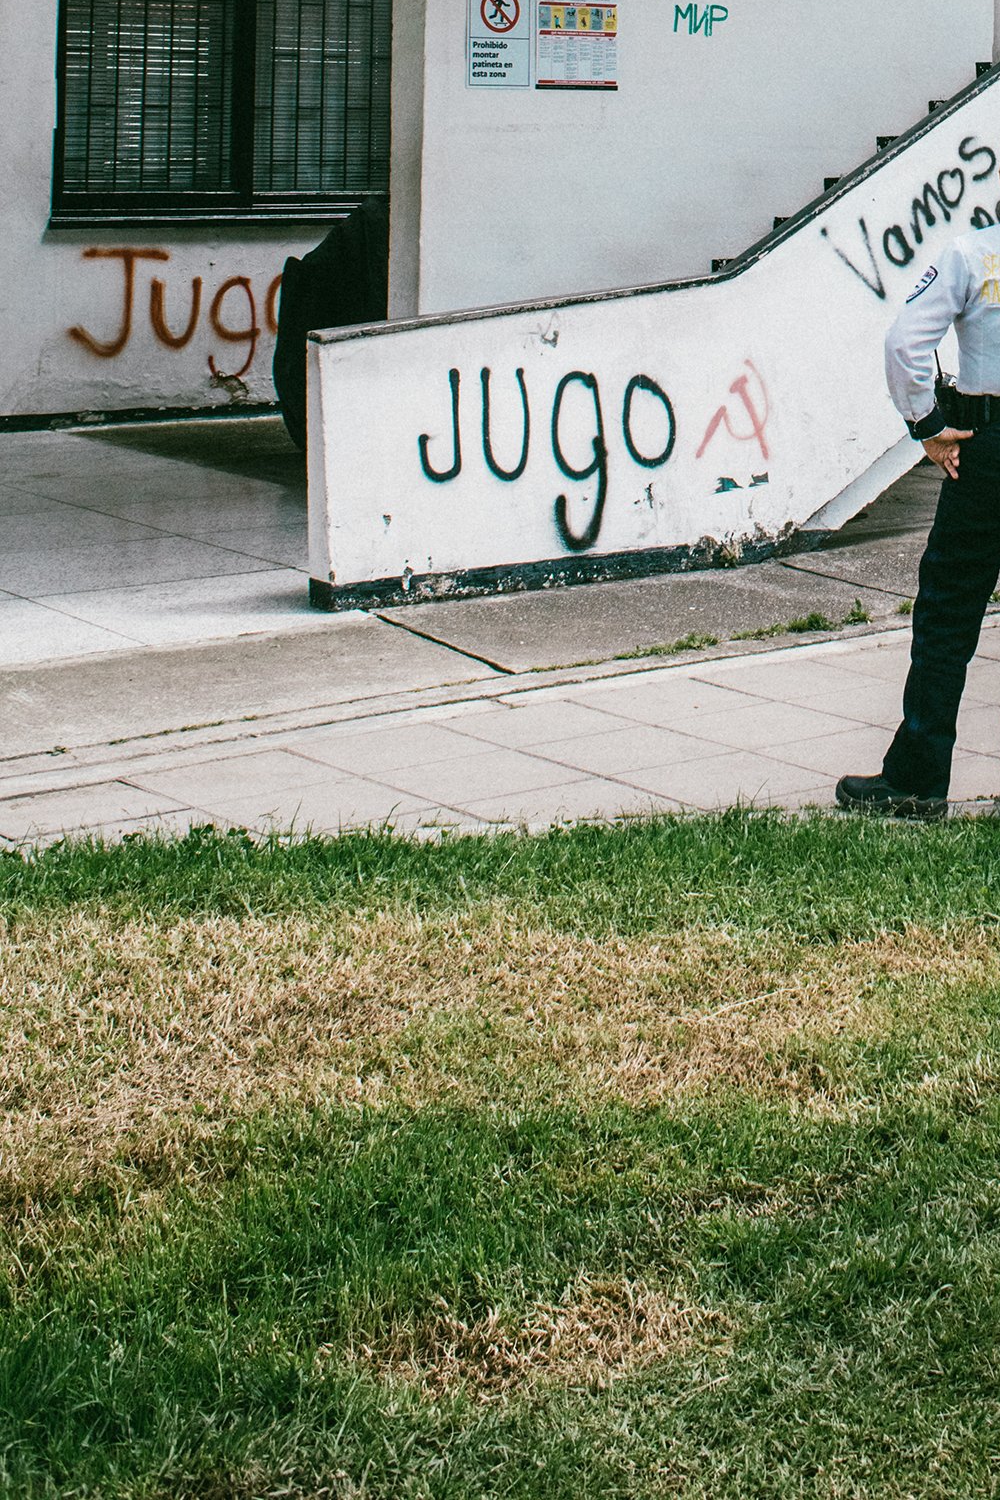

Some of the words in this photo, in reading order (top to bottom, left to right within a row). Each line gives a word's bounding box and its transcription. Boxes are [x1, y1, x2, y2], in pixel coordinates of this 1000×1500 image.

[472, 41, 508, 49] Prohibido
[472, 60, 503, 69] patineta
[820, 136, 997, 300] Vamos
